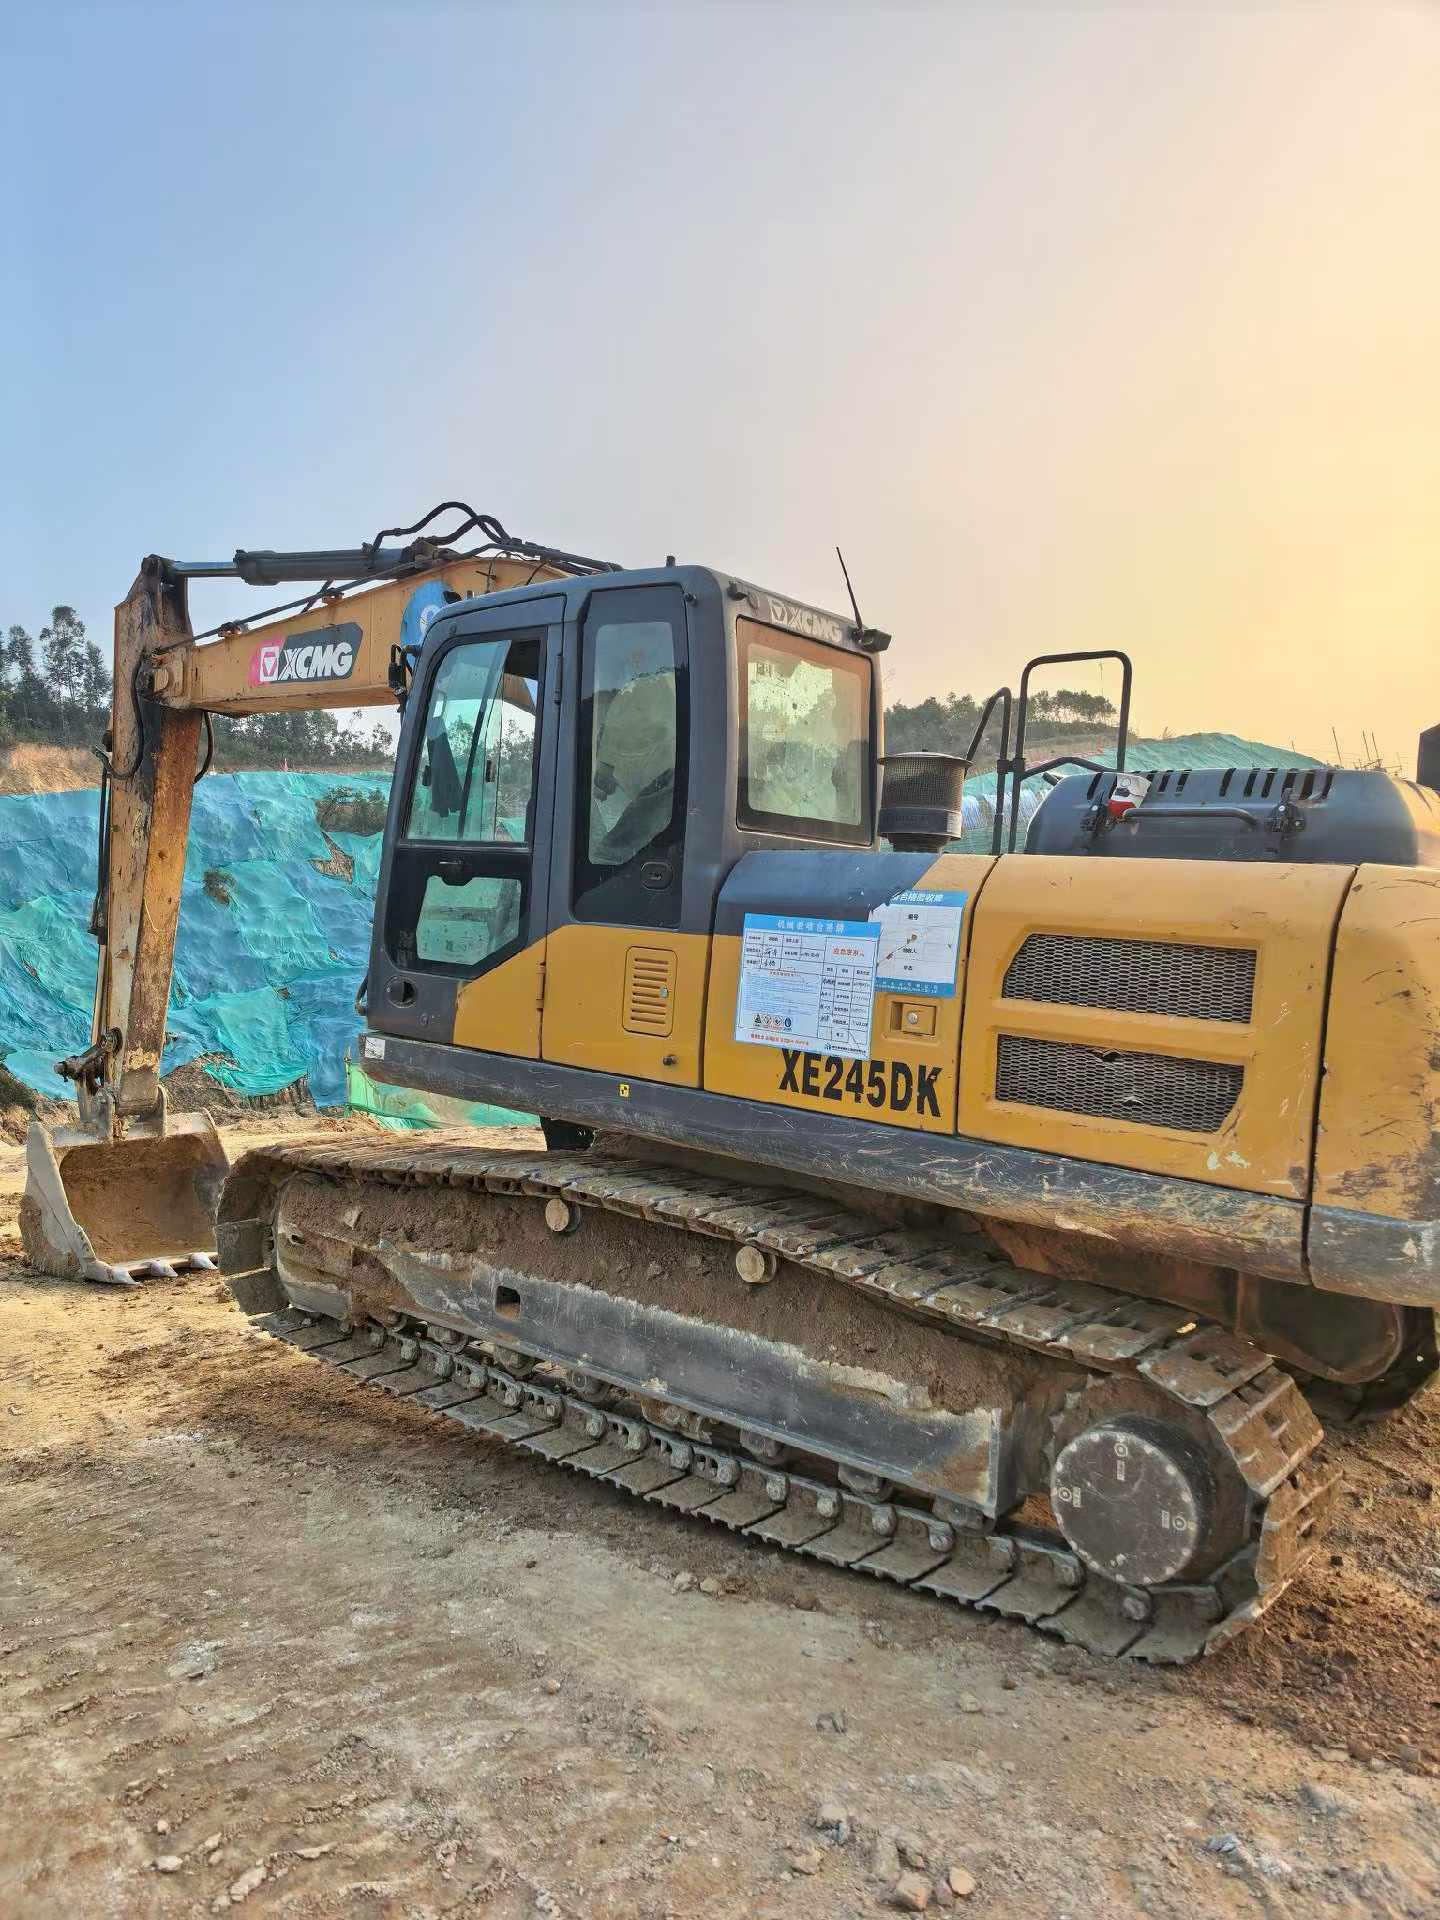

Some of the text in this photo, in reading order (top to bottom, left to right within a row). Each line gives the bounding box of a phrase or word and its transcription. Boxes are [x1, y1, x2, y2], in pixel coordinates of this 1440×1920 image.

[788, 606, 842, 642] XCMG
[278, 642, 353, 680] XCMG
[778, 1048, 943, 1118] XE245DK
